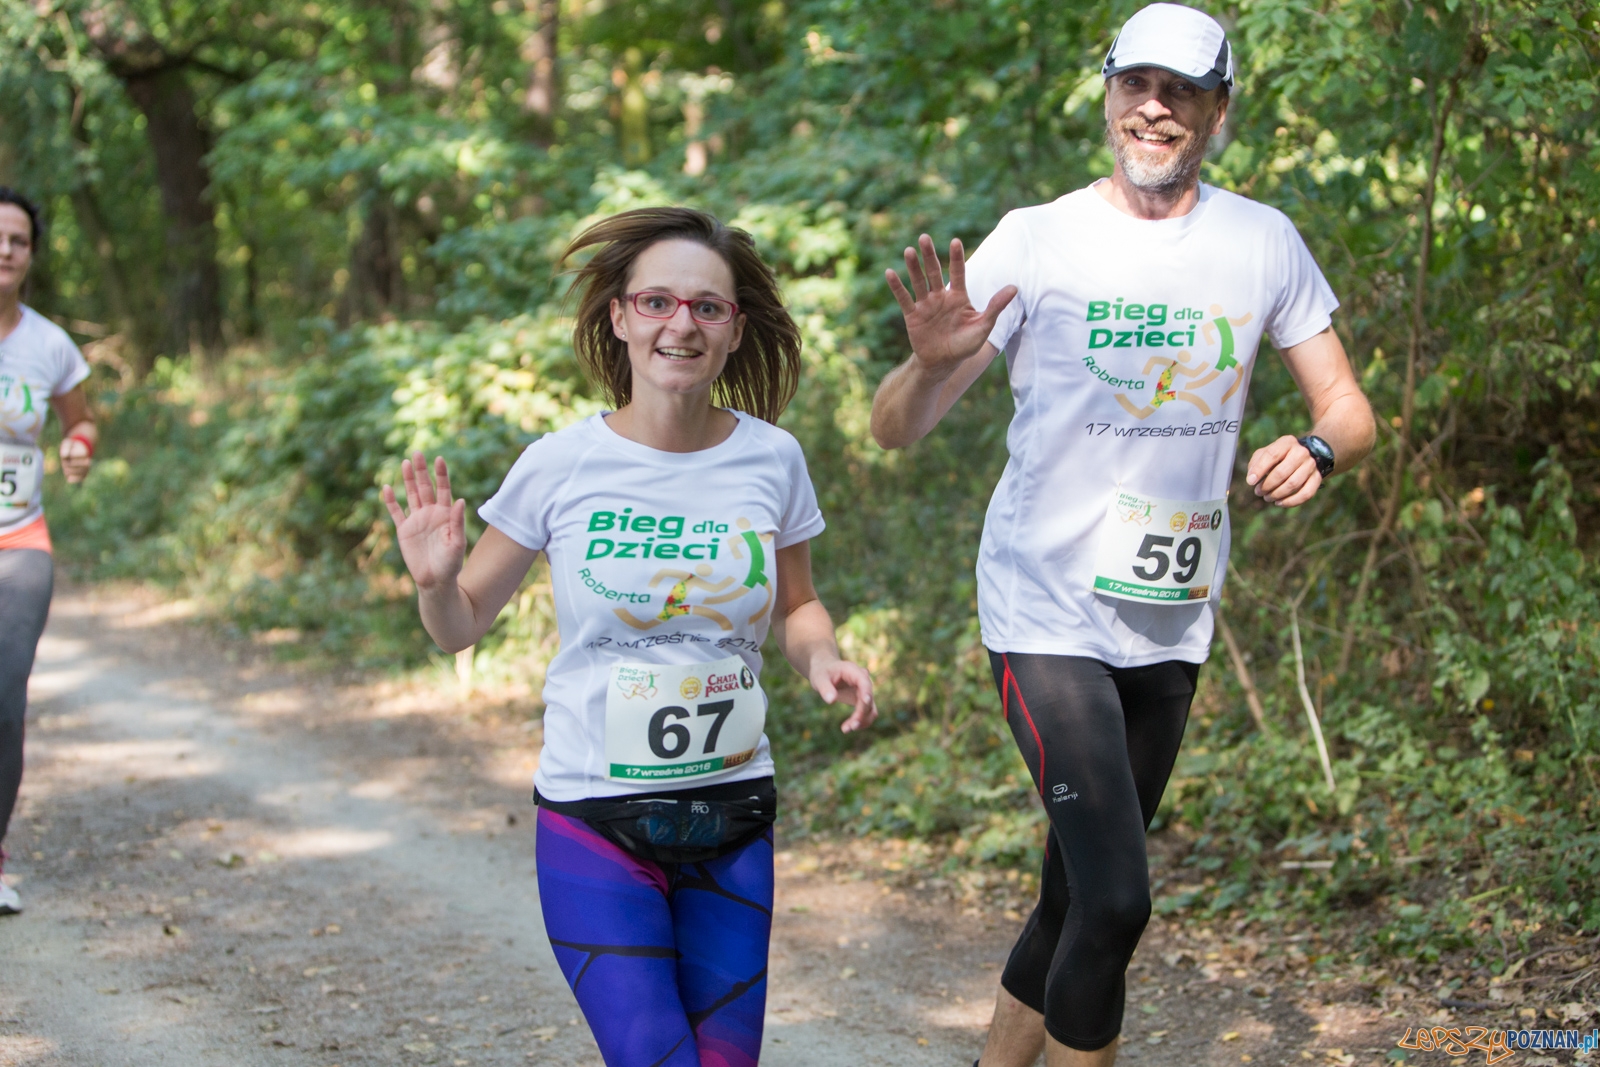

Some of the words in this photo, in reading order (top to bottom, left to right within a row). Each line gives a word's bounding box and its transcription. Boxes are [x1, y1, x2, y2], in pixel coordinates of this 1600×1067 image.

[1086, 297, 1168, 326] Bieg
[1173, 308, 1204, 320] dla
[1088, 324, 1196, 349] Dzieci
[1082, 355, 1145, 390] Roberta
[1085, 422, 1111, 436] 17
[1114, 423, 1196, 437] września
[1199, 419, 1239, 436] 2016
[587, 507, 685, 539] Bieg
[692, 520, 729, 533] dla
[585, 537, 720, 561] Dzieci
[1132, 533, 1202, 584] 59
[577, 567, 651, 604] Roberta
[1108, 581, 1123, 590] 17
[1158, 590, 1181, 599] 2016
[705, 681, 740, 698] POLSKA
[707, 673, 738, 686] CHATA
[648, 699, 735, 759] 67
[625, 767, 640, 776] 17
[684, 762, 711, 774] 2016
[691, 804, 710, 814] PRO
